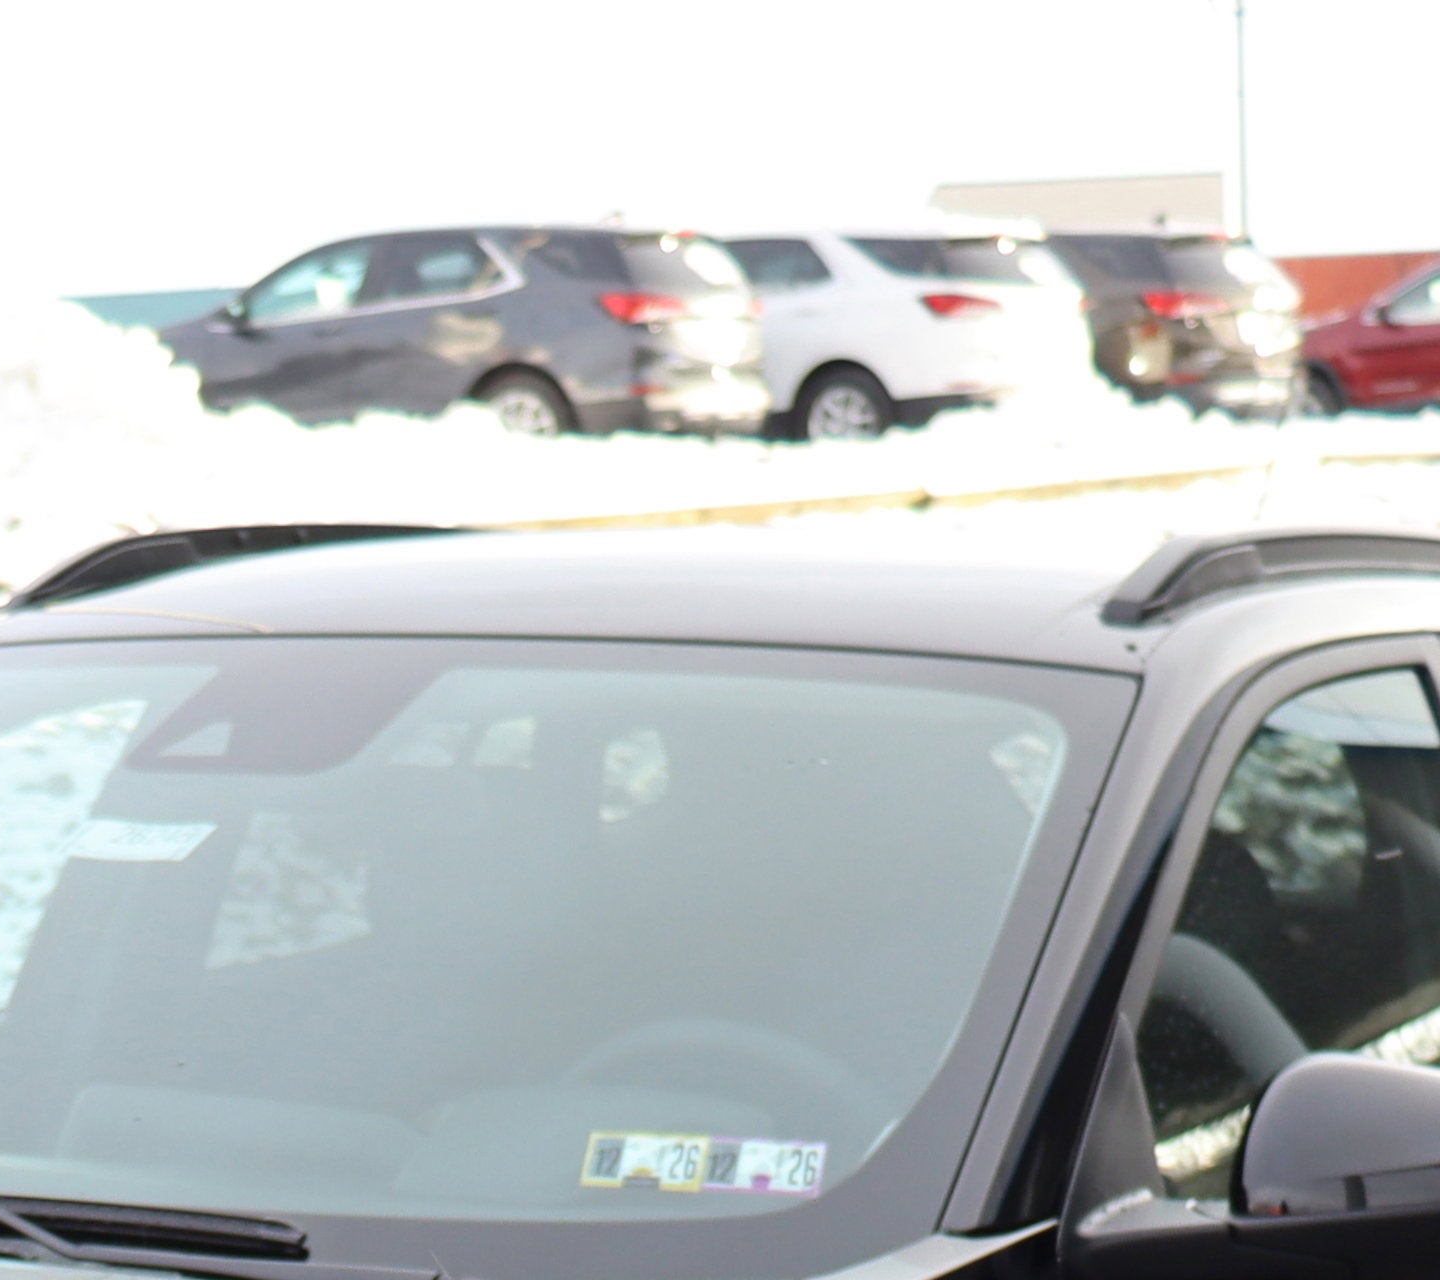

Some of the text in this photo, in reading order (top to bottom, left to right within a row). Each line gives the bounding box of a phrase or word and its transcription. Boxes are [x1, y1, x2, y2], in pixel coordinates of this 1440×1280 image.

[595, 1147, 621, 1178] 12
[668, 1144, 700, 1180] 26
[708, 1152, 737, 1184] 12
[786, 1148, 819, 1187] 26
